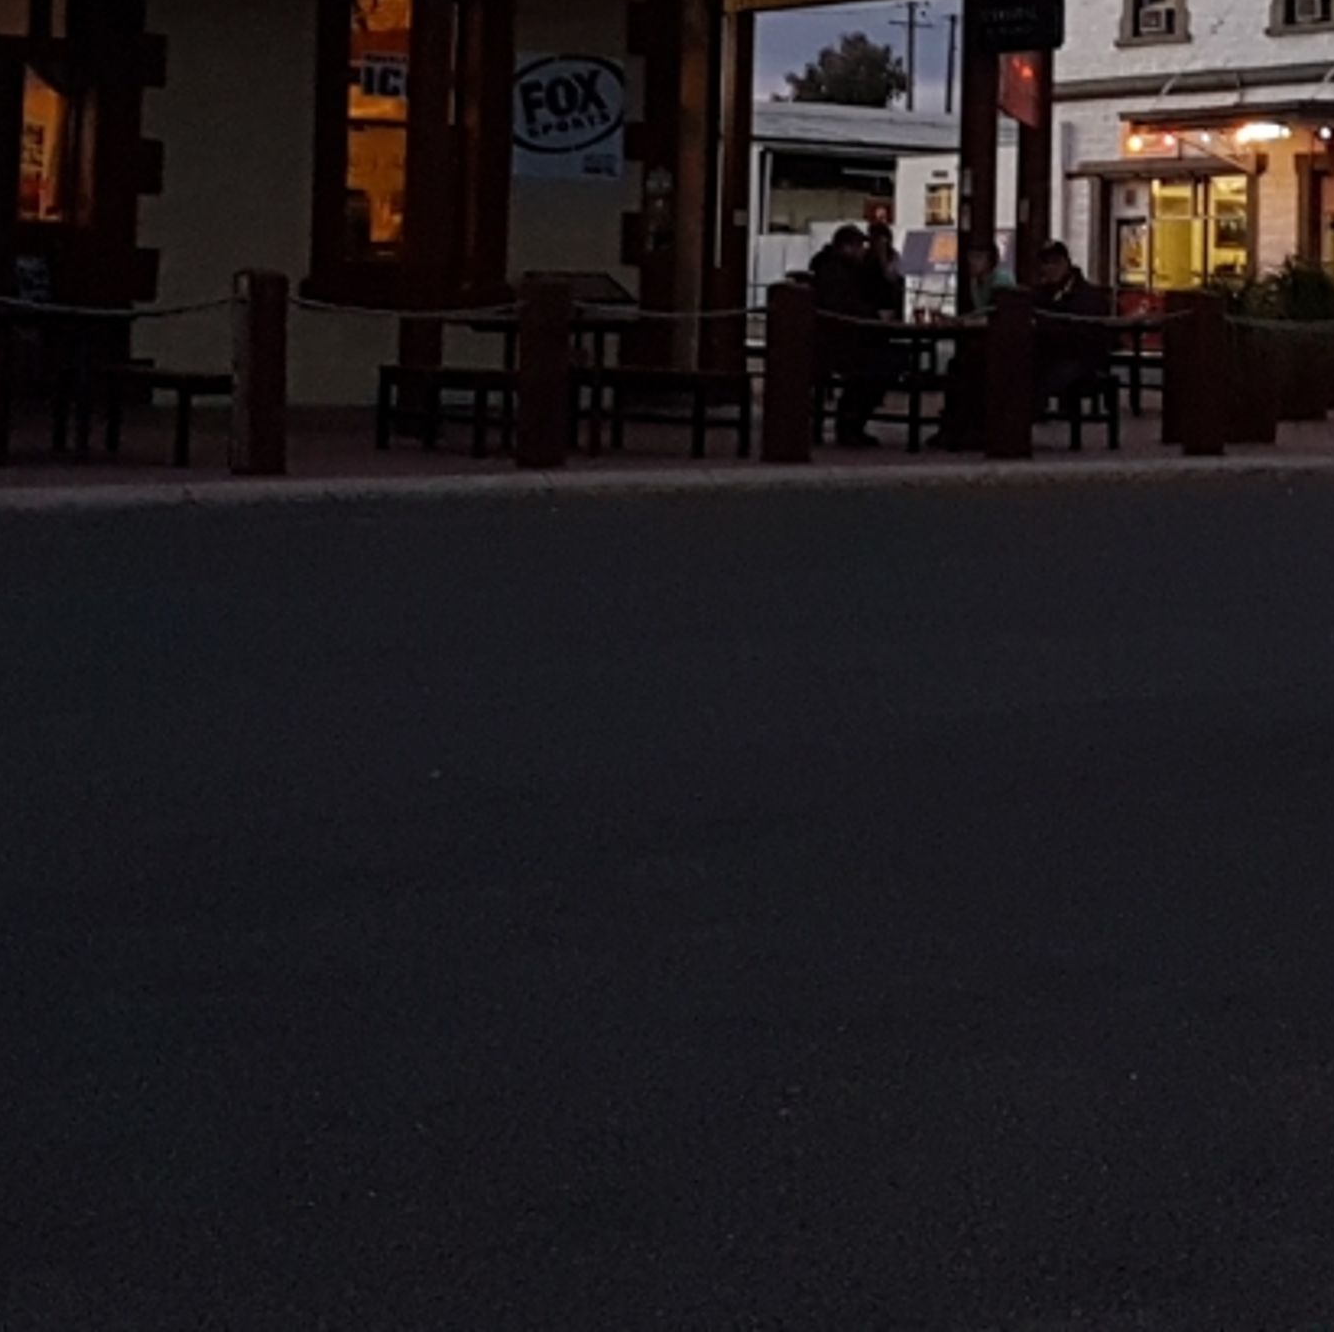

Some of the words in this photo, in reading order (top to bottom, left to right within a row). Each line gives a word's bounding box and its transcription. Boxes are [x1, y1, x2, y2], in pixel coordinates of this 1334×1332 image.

[364, 67, 410, 97] IC
[521, 69, 607, 124] FOX
[527, 111, 611, 139] SPORTS
